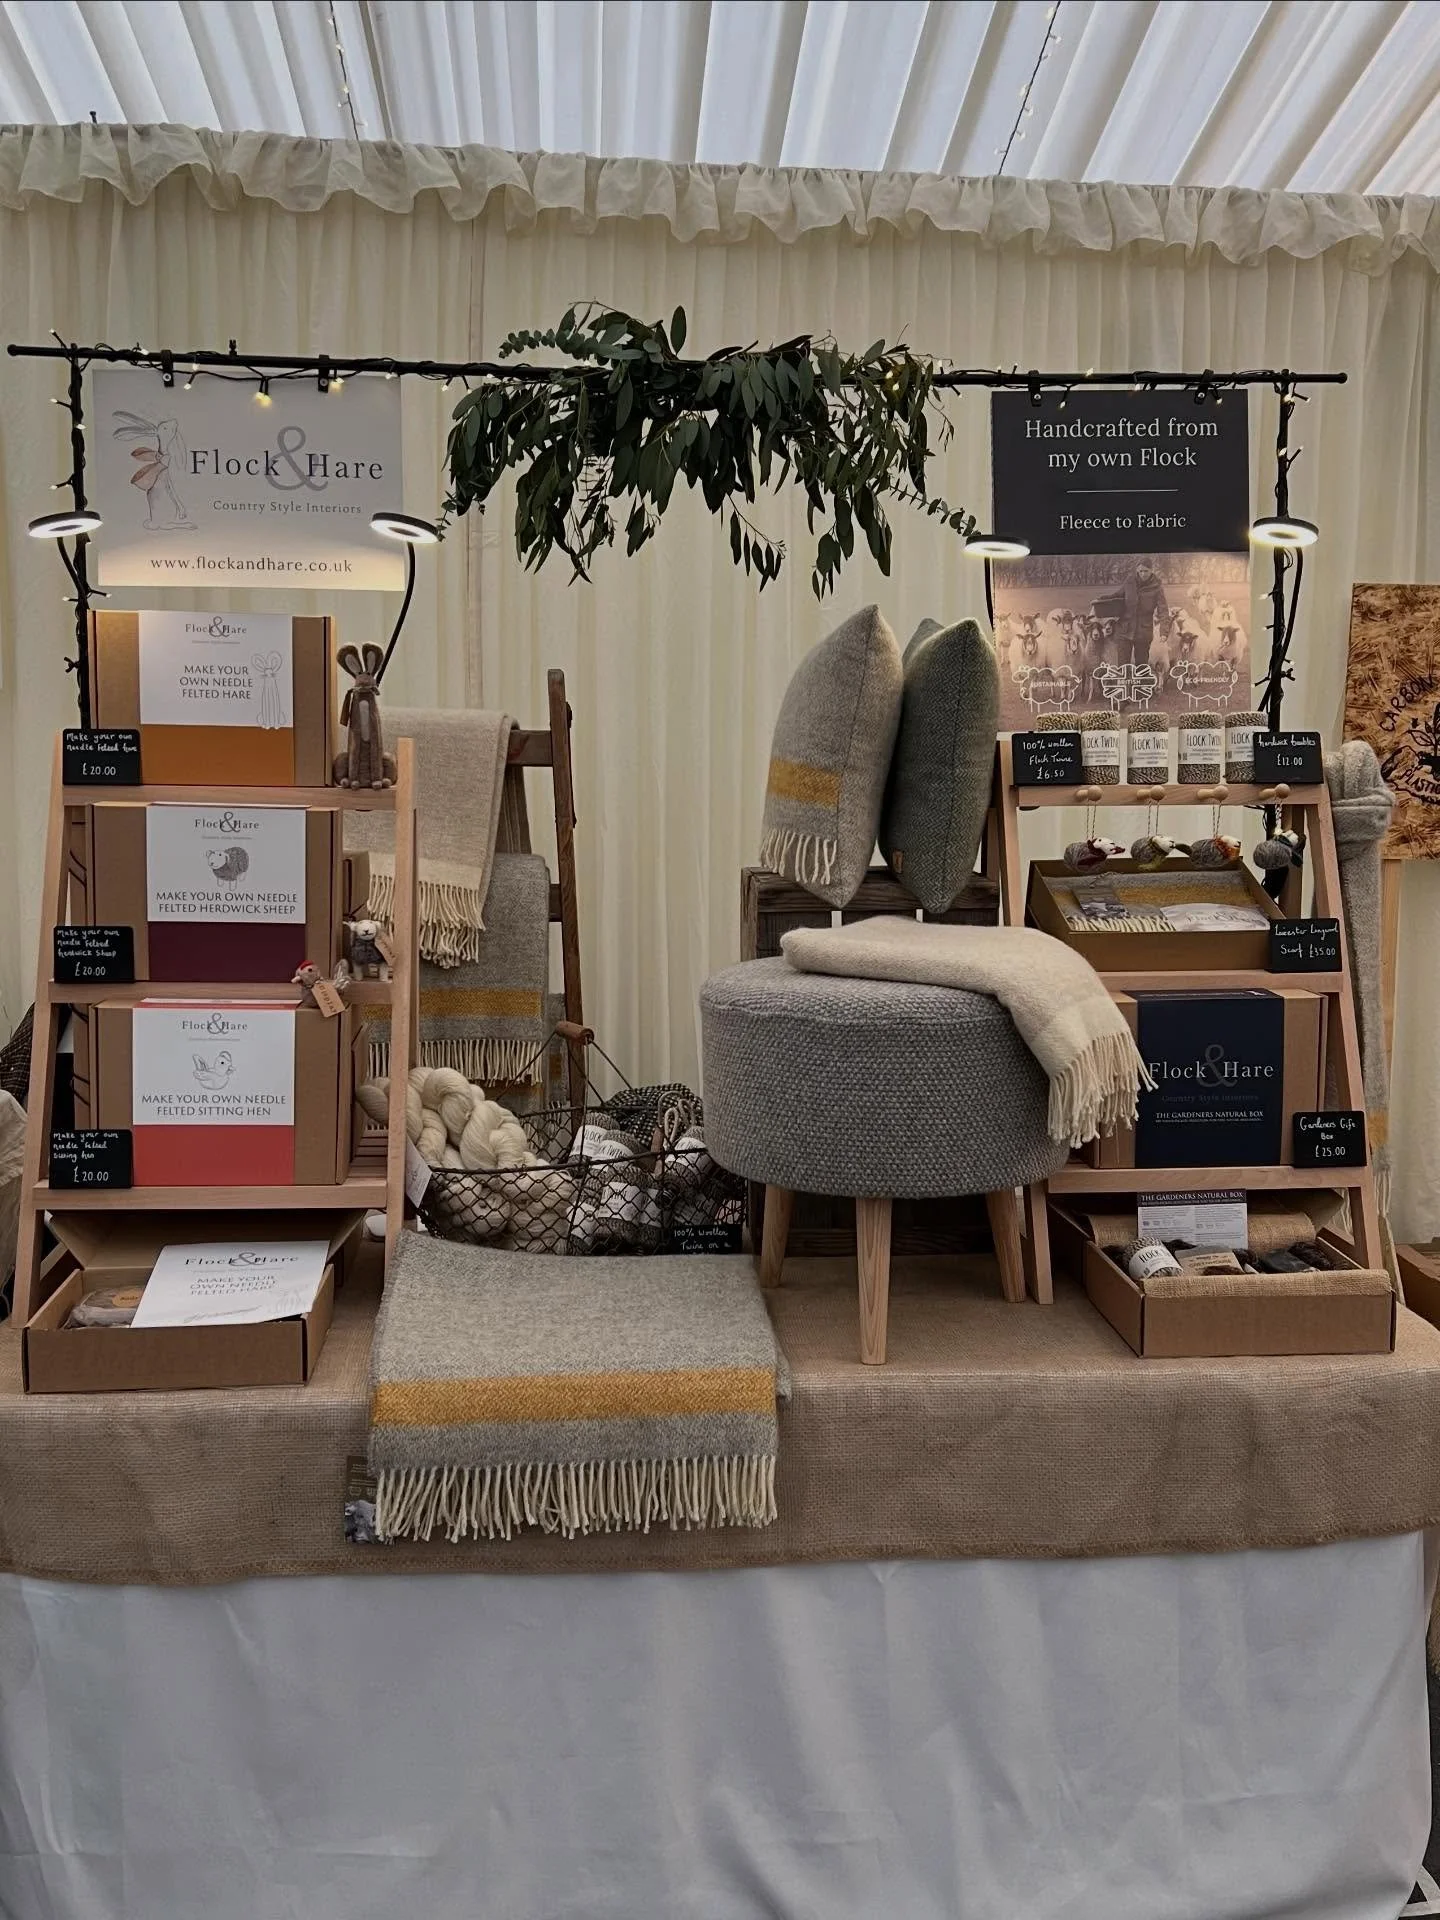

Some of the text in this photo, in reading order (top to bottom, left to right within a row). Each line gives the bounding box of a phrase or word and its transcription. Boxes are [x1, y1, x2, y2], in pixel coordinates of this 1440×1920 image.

[1025, 417, 1218, 438] Handcrafted from
[190, 426, 383, 491] Flock & Hare
[1048, 447, 1197, 473] my own Flock
[213, 500, 361, 514] Country Style Interiors
[1060, 513, 1187, 530] Fleece to Fabric
[150, 556, 352, 573] www.flockandhare.co.uk
[185, 623, 214, 633] Flock
[223, 625, 247, 634] Hare
[184, 665, 249, 675] MAKE YOUR
[180, 677, 254, 688] OWN NEEDLE
[182, 689, 251, 699] FELTED HARE
[1380, 674, 1433, 731] CARBON
[66, 733, 88, 742] Make
[93, 734, 115, 743] your
[1023, 739, 1045, 750] 100%
[1277, 753, 1303, 766] £12.00
[82, 762, 117, 776] £20.00
[1037, 766, 1065, 779] £6.50
[195, 819, 224, 829] Flock
[234, 820, 259, 829] Hare
[156, 892, 297, 902] MAKE YOUR OWN NEEDLE
[159, 903, 296, 914] FELTED HERDWICK SHEEP
[82, 930, 101, 940] your
[75, 961, 106, 977] £20.00
[182, 1020, 212, 1030] Flock
[222, 1021, 248, 1030] Hare
[1149, 1044, 1274, 1088] Flock & Hare
[141, 1094, 286, 1105] MAKE YOUR OWN NEEDLE
[157, 1106, 271, 1116] FELTED SITTING HEN
[80, 1132, 99, 1142] your
[1315, 1145, 1346, 1158] £25.00
[73, 1165, 109, 1183] £20.00
[1156, 1193, 1196, 1201] GARDENERS
[1198, 1192, 1228, 1200] NATURAL
[674, 1227, 695, 1237] 100%
